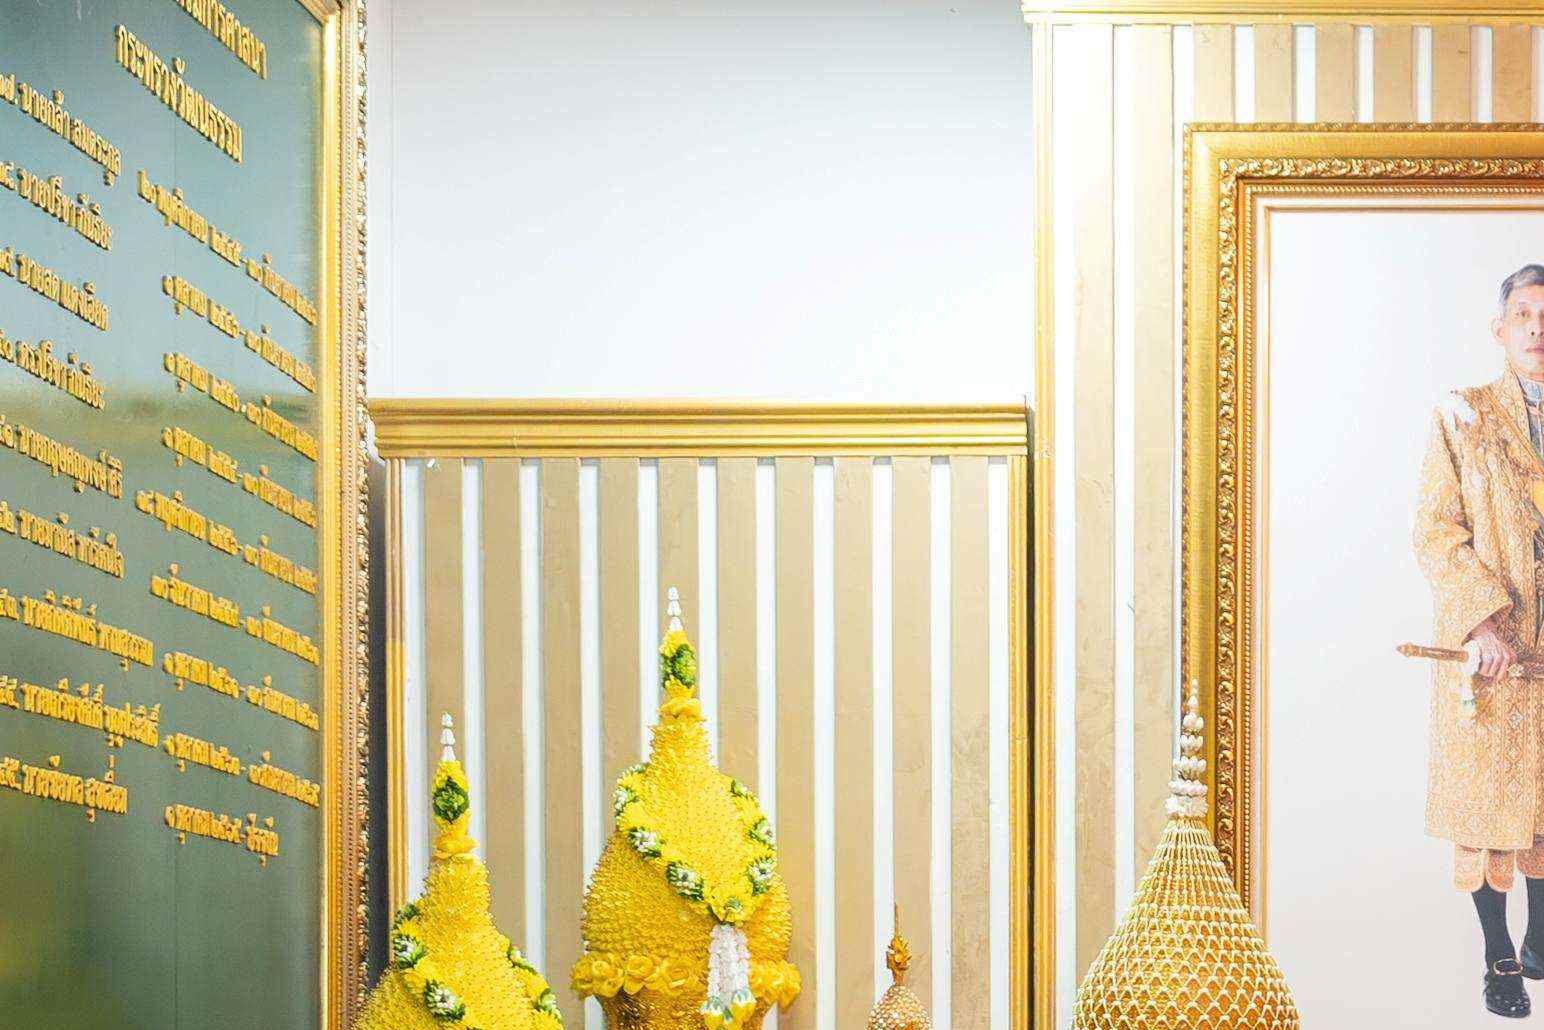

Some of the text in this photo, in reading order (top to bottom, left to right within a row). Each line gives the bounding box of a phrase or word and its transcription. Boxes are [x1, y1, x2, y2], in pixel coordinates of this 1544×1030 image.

[115, 24, 243, 163] กระทรวงวัฒนธรรม
[174, 0, 268, 80] มการศาสนา
